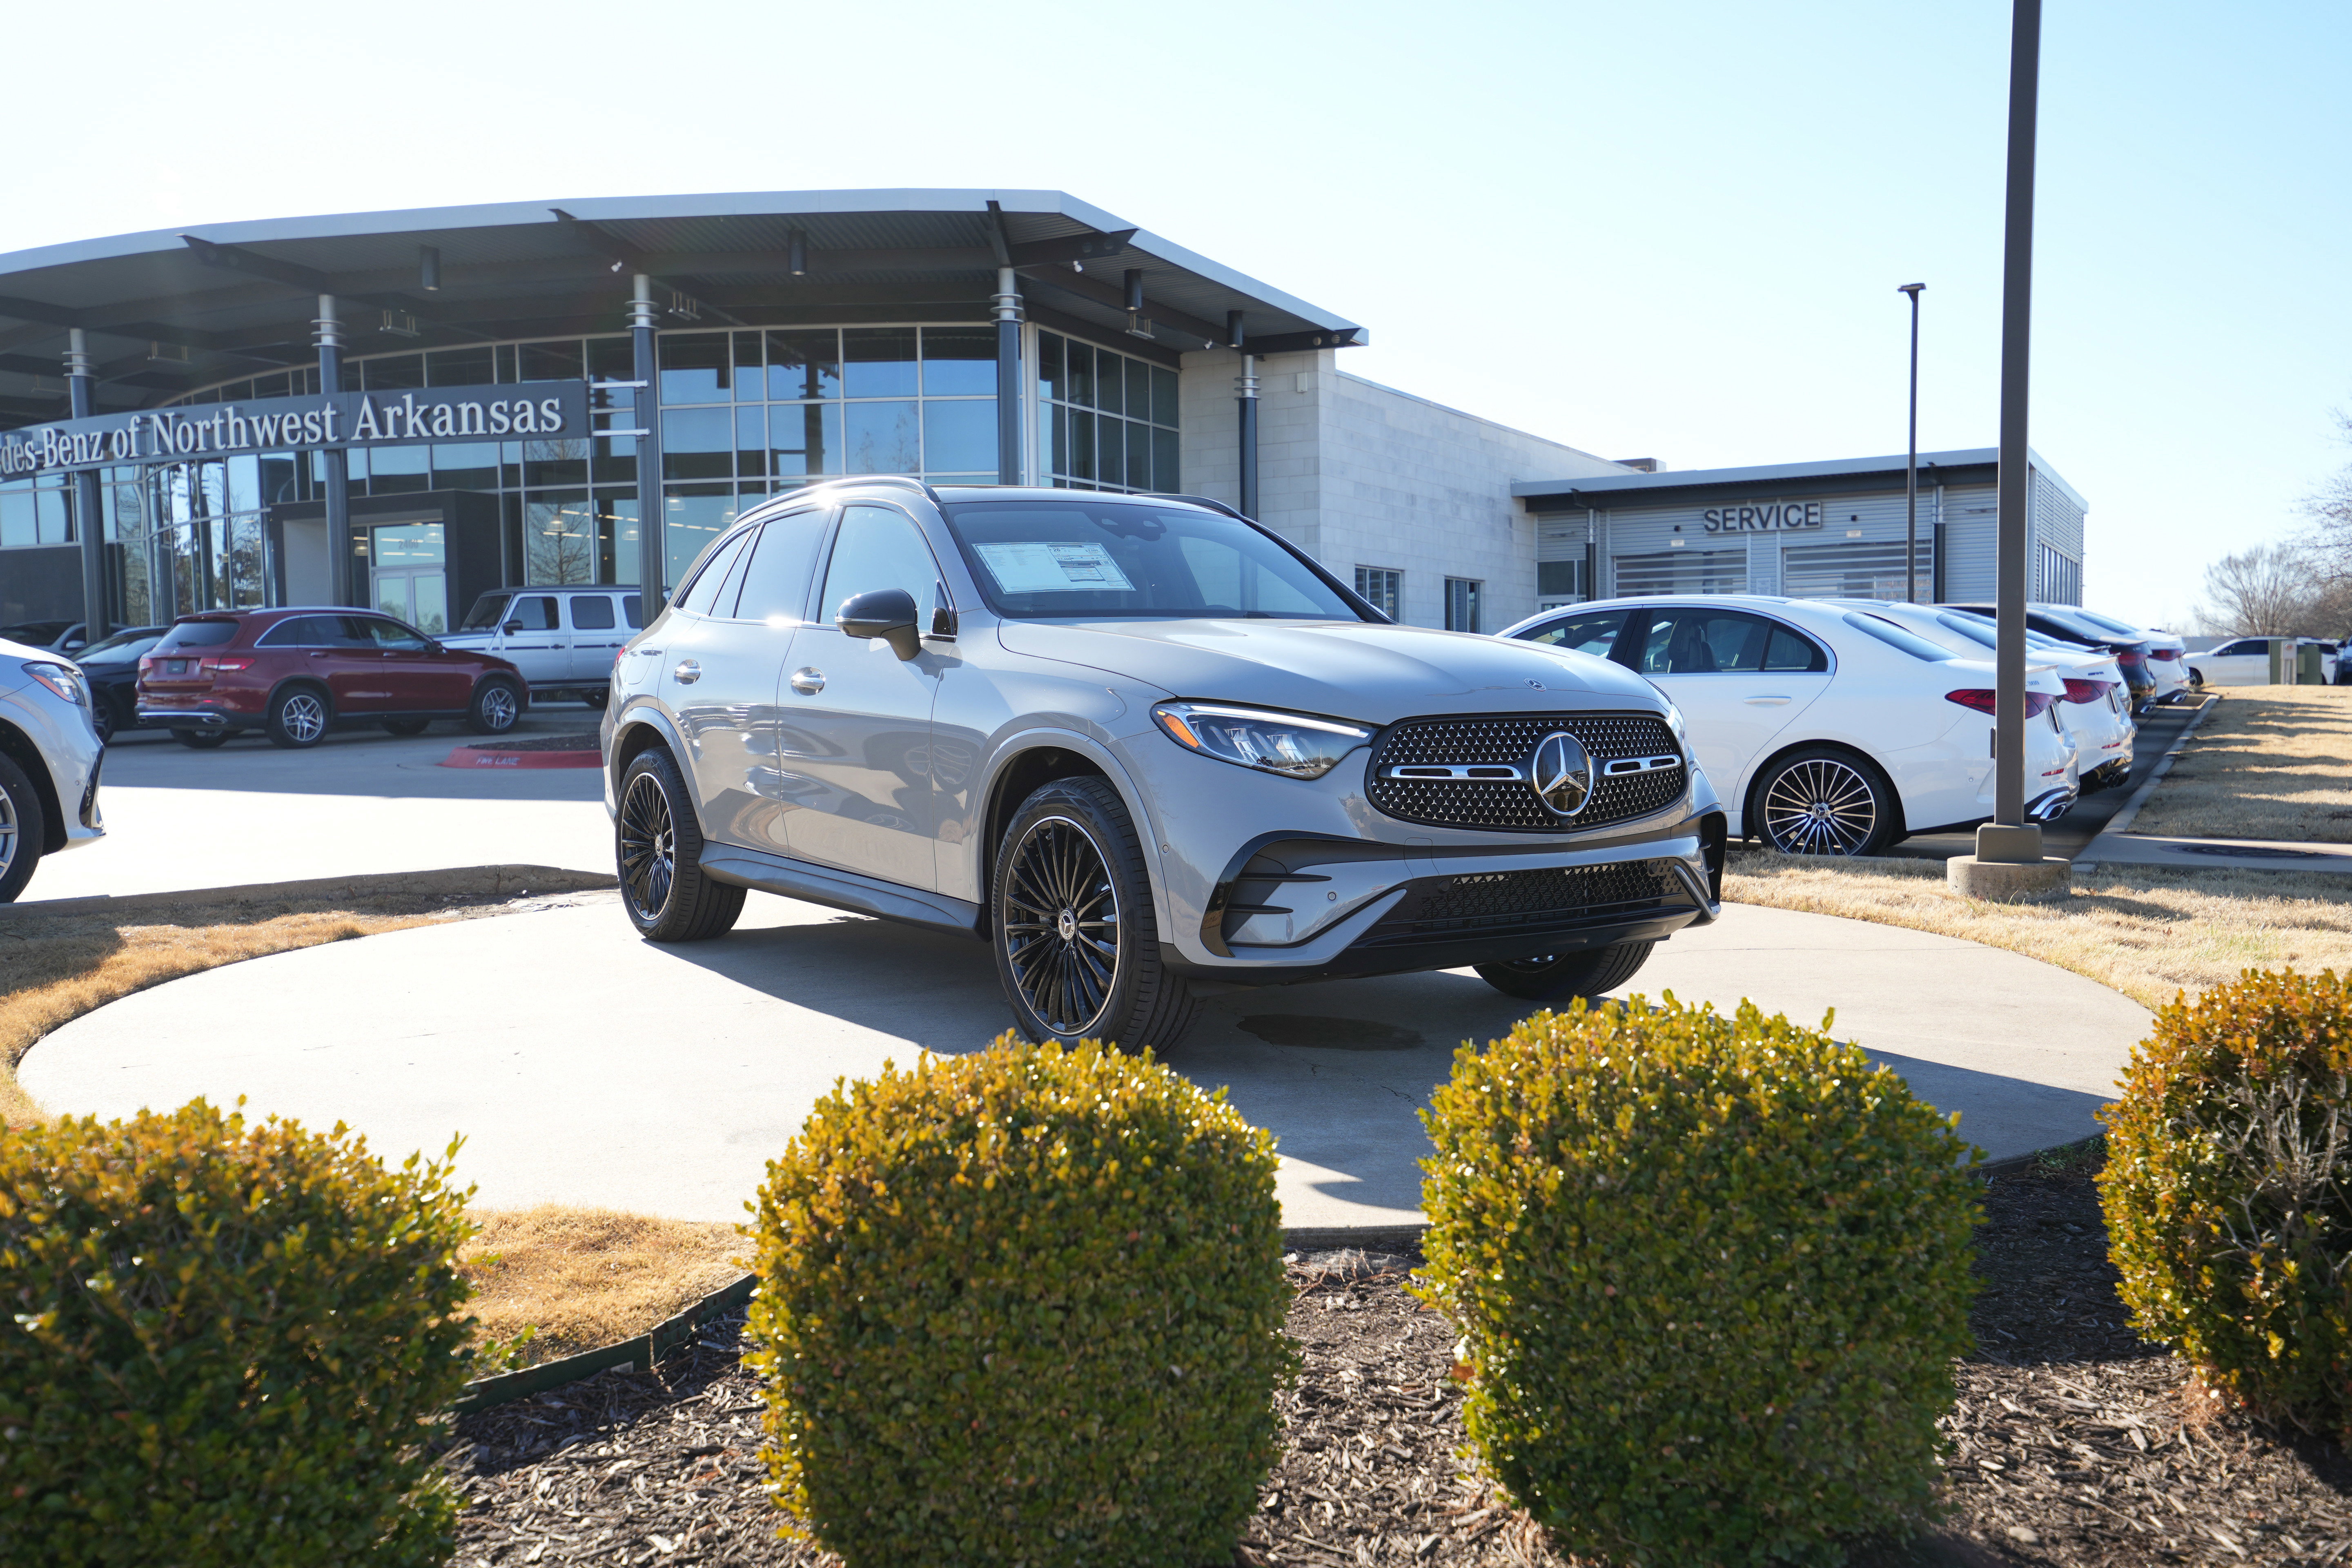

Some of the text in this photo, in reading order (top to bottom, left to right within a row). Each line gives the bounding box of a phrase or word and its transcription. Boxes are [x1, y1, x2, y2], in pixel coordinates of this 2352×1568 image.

[0, 393, 562, 474] des-Benz of Northwest Arkansas
[1704, 503, 1819, 532] SERVICE
[495, 757, 521, 766] LANE
[1093, 821, 1117, 865] EcoContact
[671, 842, 679, 898] Continental
[992, 838, 1010, 918] Continental
